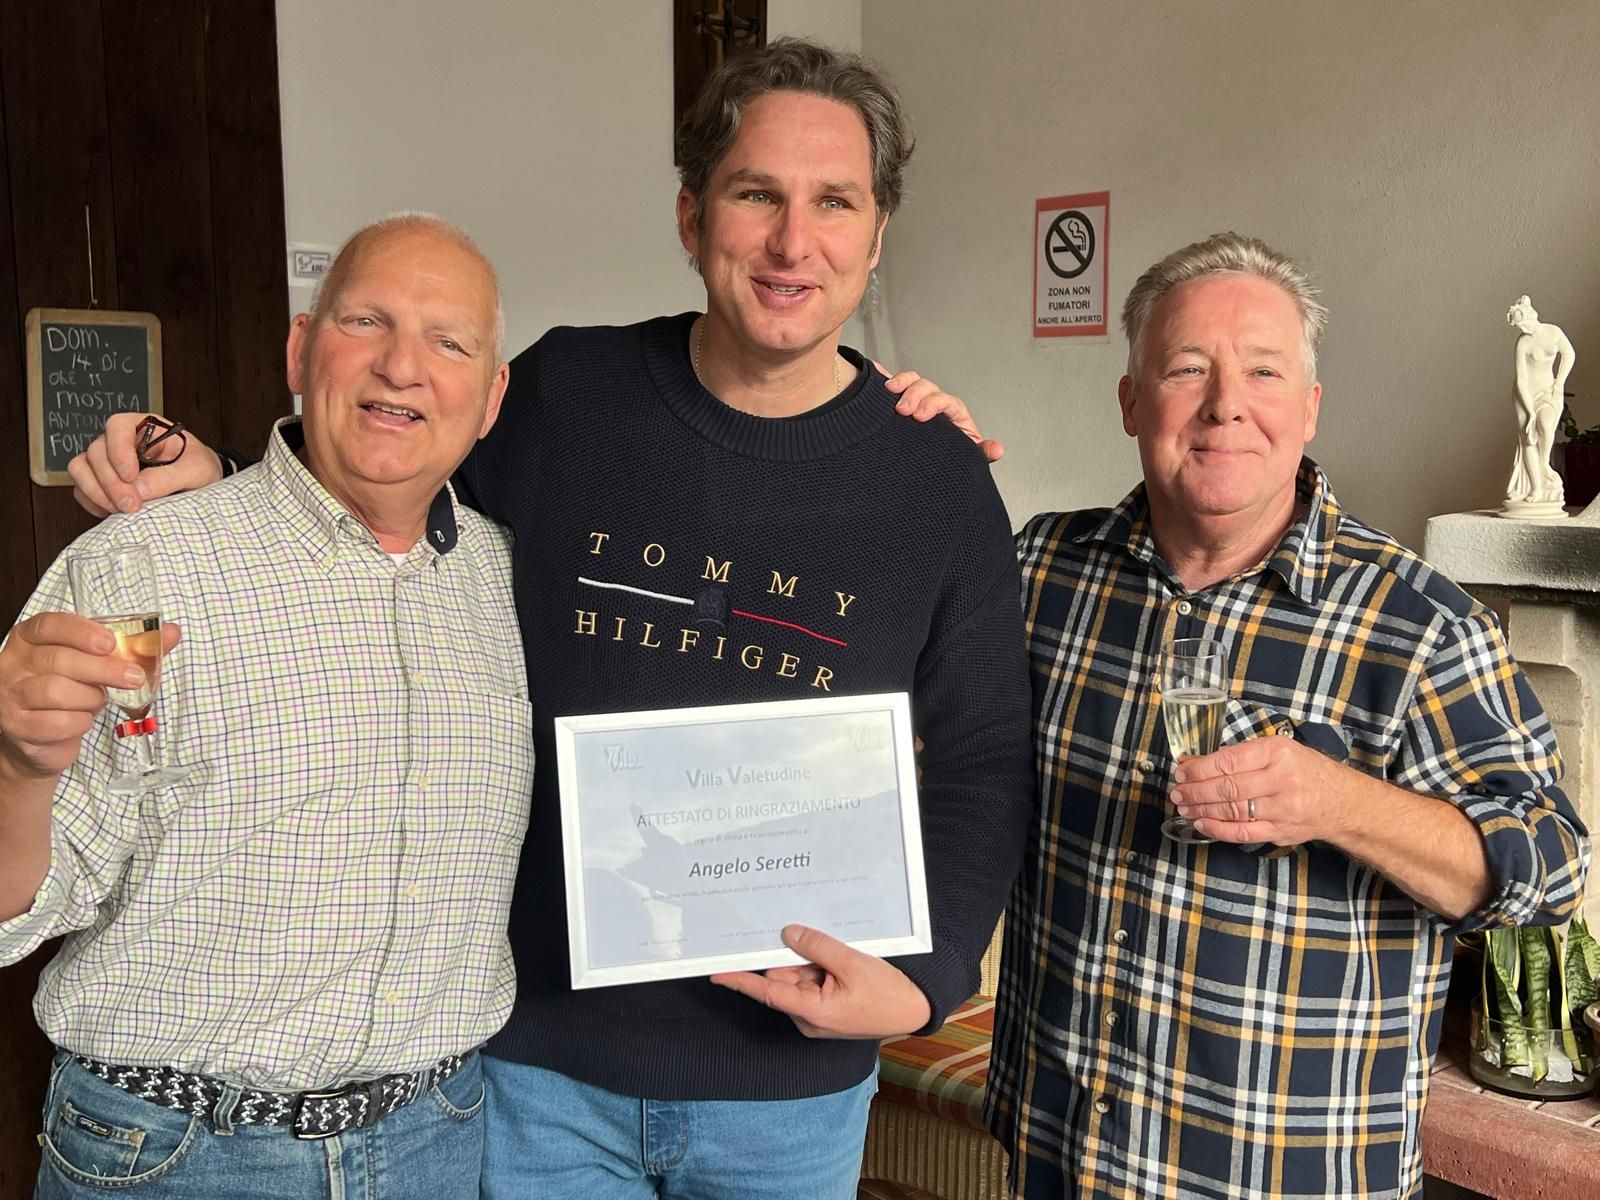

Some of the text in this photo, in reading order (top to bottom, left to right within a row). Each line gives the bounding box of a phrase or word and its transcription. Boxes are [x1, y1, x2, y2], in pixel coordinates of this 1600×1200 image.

[1047, 286, 1091, 297] ZONA NON
[1048, 300, 1090, 310] FUMATORI
[1060, 314, 1102, 323] ALL'APERTO
[589, 532, 856, 617] TOMMY
[574, 609, 834, 691] HILFIGER
[685, 765, 811, 789] Villa Valetudine
[637, 796, 861, 827] ATTESTATO DI RINGRAZIAMENTO
[688, 851, 811, 879] Angelo Seretti
